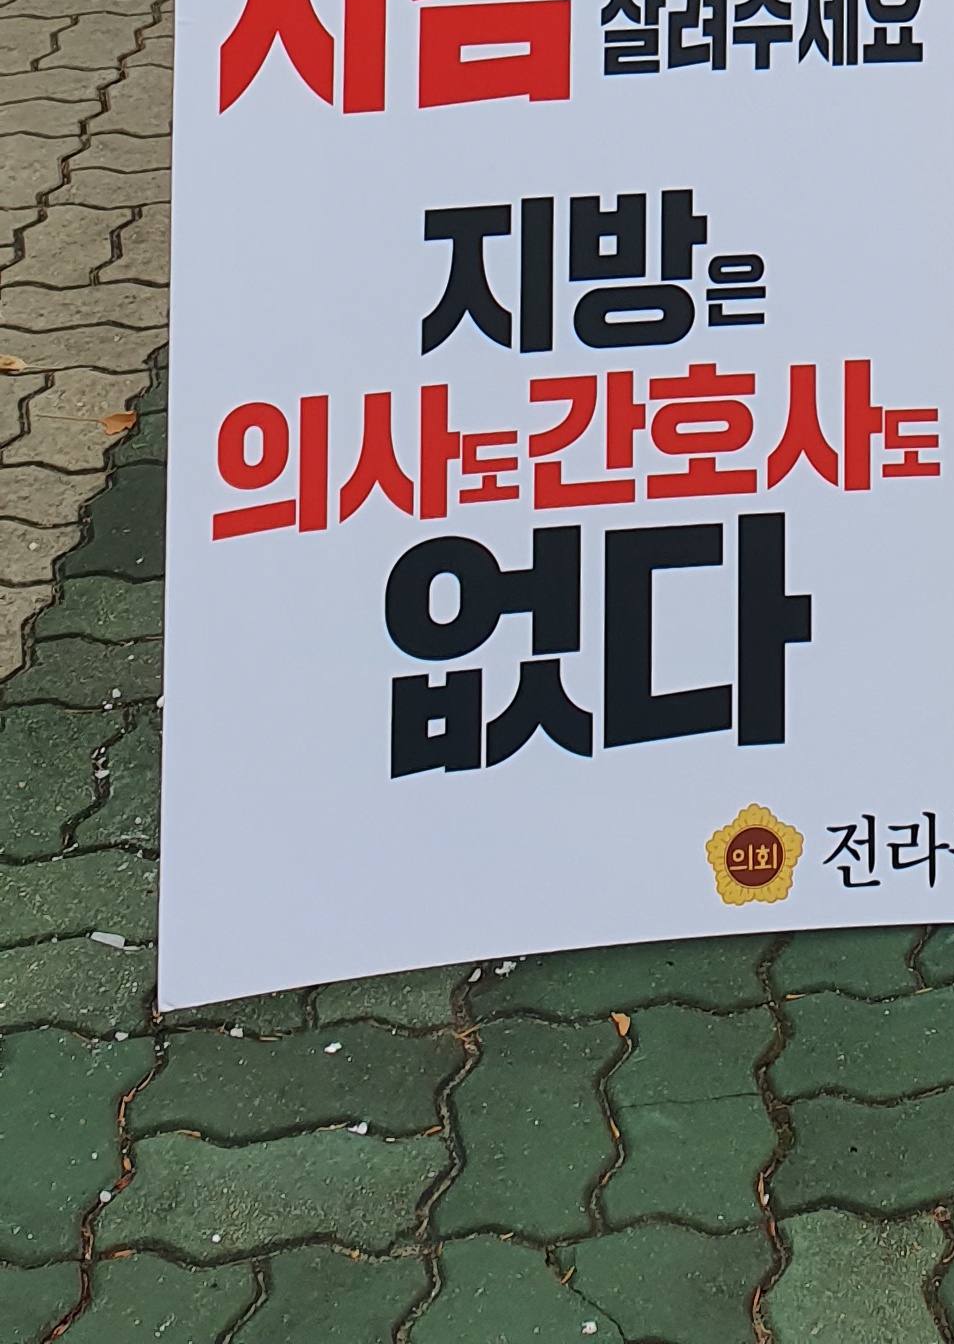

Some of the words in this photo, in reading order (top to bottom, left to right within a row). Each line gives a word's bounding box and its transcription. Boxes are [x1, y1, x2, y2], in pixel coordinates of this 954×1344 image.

[421, 189, 767, 357] 지방은
[384, 512, 813, 780] 없다
[729, 842, 778, 872] 의회
